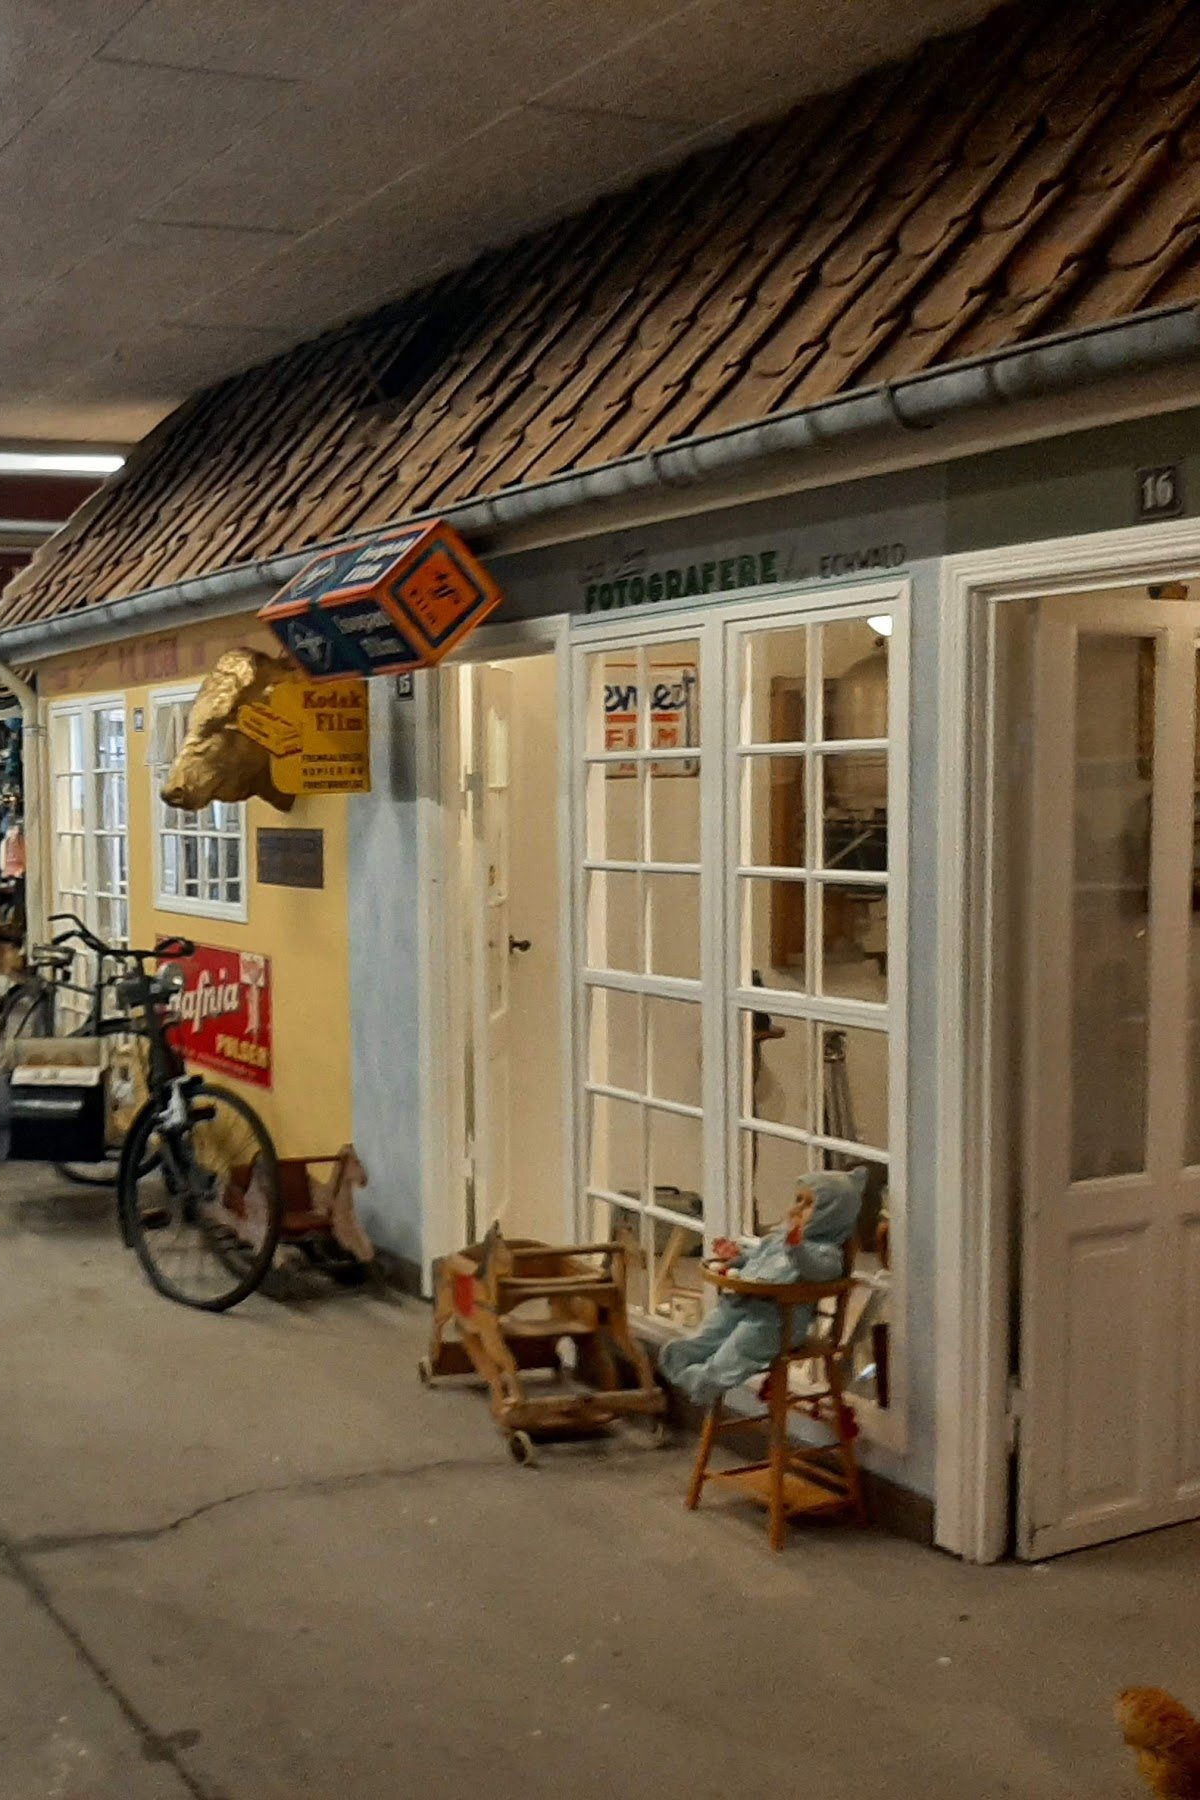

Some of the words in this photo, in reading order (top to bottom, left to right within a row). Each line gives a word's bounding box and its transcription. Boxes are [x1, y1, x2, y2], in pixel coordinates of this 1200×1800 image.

[1143, 471, 1173, 510] 16
[303, 690, 362, 709] Kodak
[316, 712, 363, 731] Film
[605, 728, 678, 750] FIM
